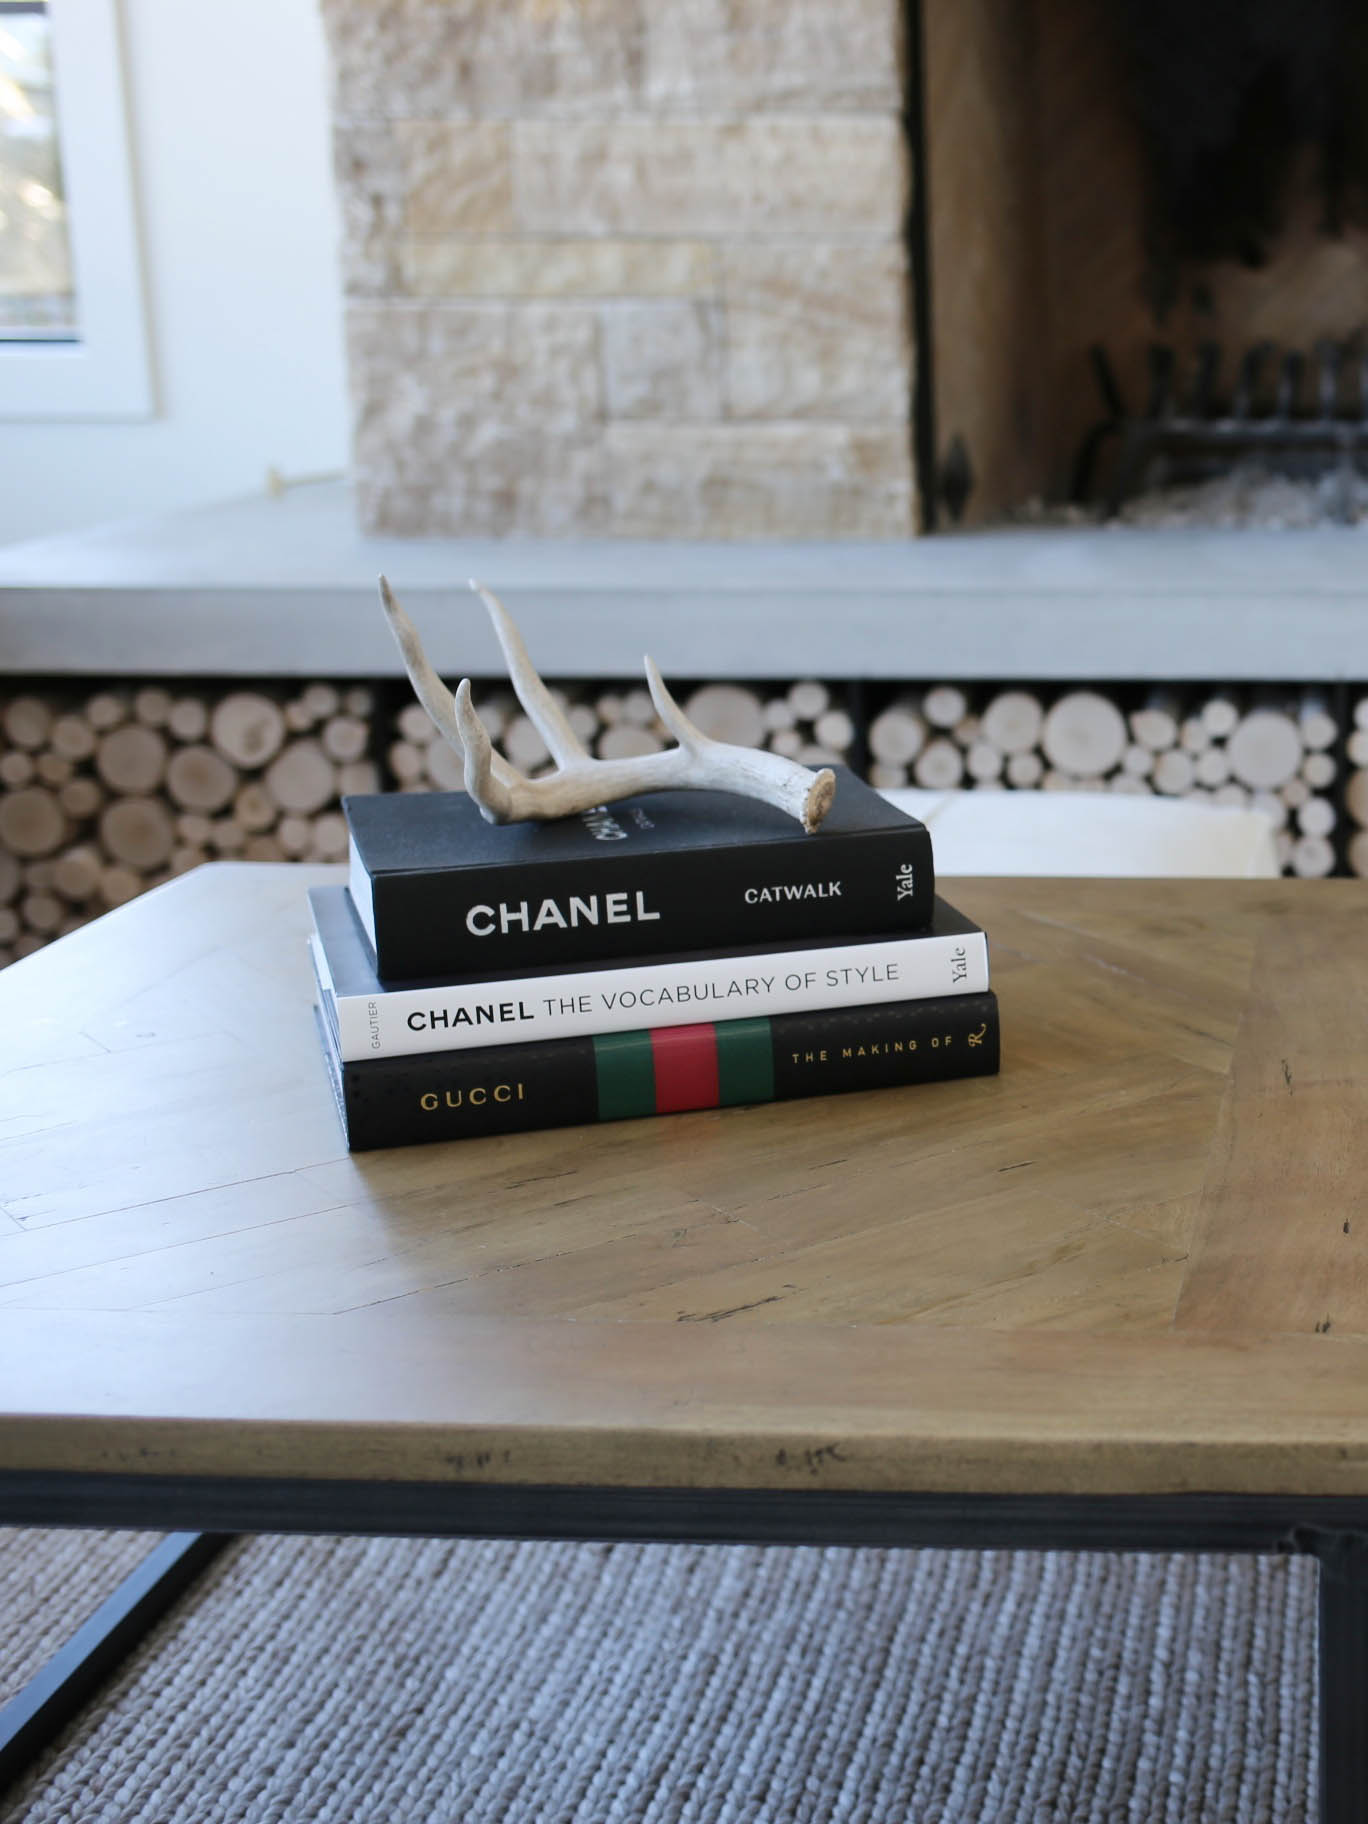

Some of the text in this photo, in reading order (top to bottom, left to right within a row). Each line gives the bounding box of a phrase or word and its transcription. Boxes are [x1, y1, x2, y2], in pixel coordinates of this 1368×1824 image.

[896, 863, 914, 901] Yale
[465, 881, 843, 937] CHANEL CATWALK
[950, 946, 968, 984] Yale
[406, 962, 900, 1032] CHANEL THE VOCABULARY OF STYLE
[368, 1001, 382, 1050] GAUTIER
[791, 1035, 953, 1065] THE MAKING OF
[420, 1083, 525, 1111] GUCCI
